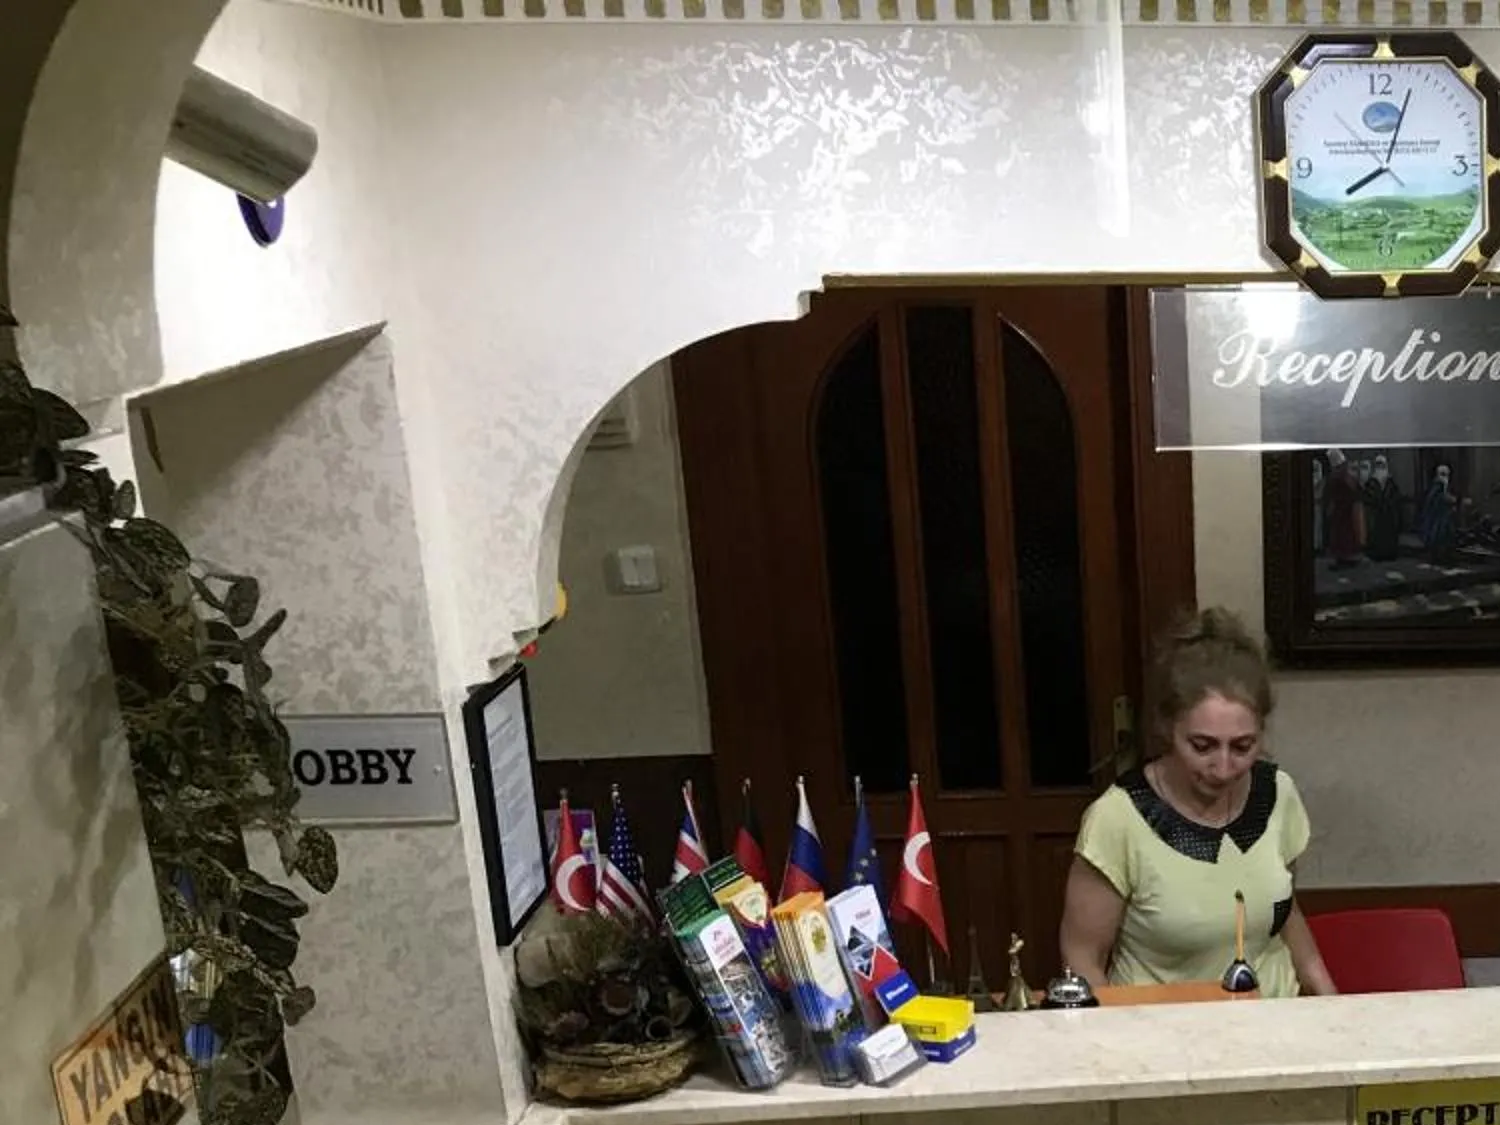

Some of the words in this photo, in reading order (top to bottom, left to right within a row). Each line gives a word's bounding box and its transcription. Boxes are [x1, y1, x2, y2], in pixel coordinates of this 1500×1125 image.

[1367, 73, 1393, 96] 12
[1296, 157, 1313, 179] 9
[1451, 154, 1469, 177] 3
[292, 748, 416, 787] OBBY
